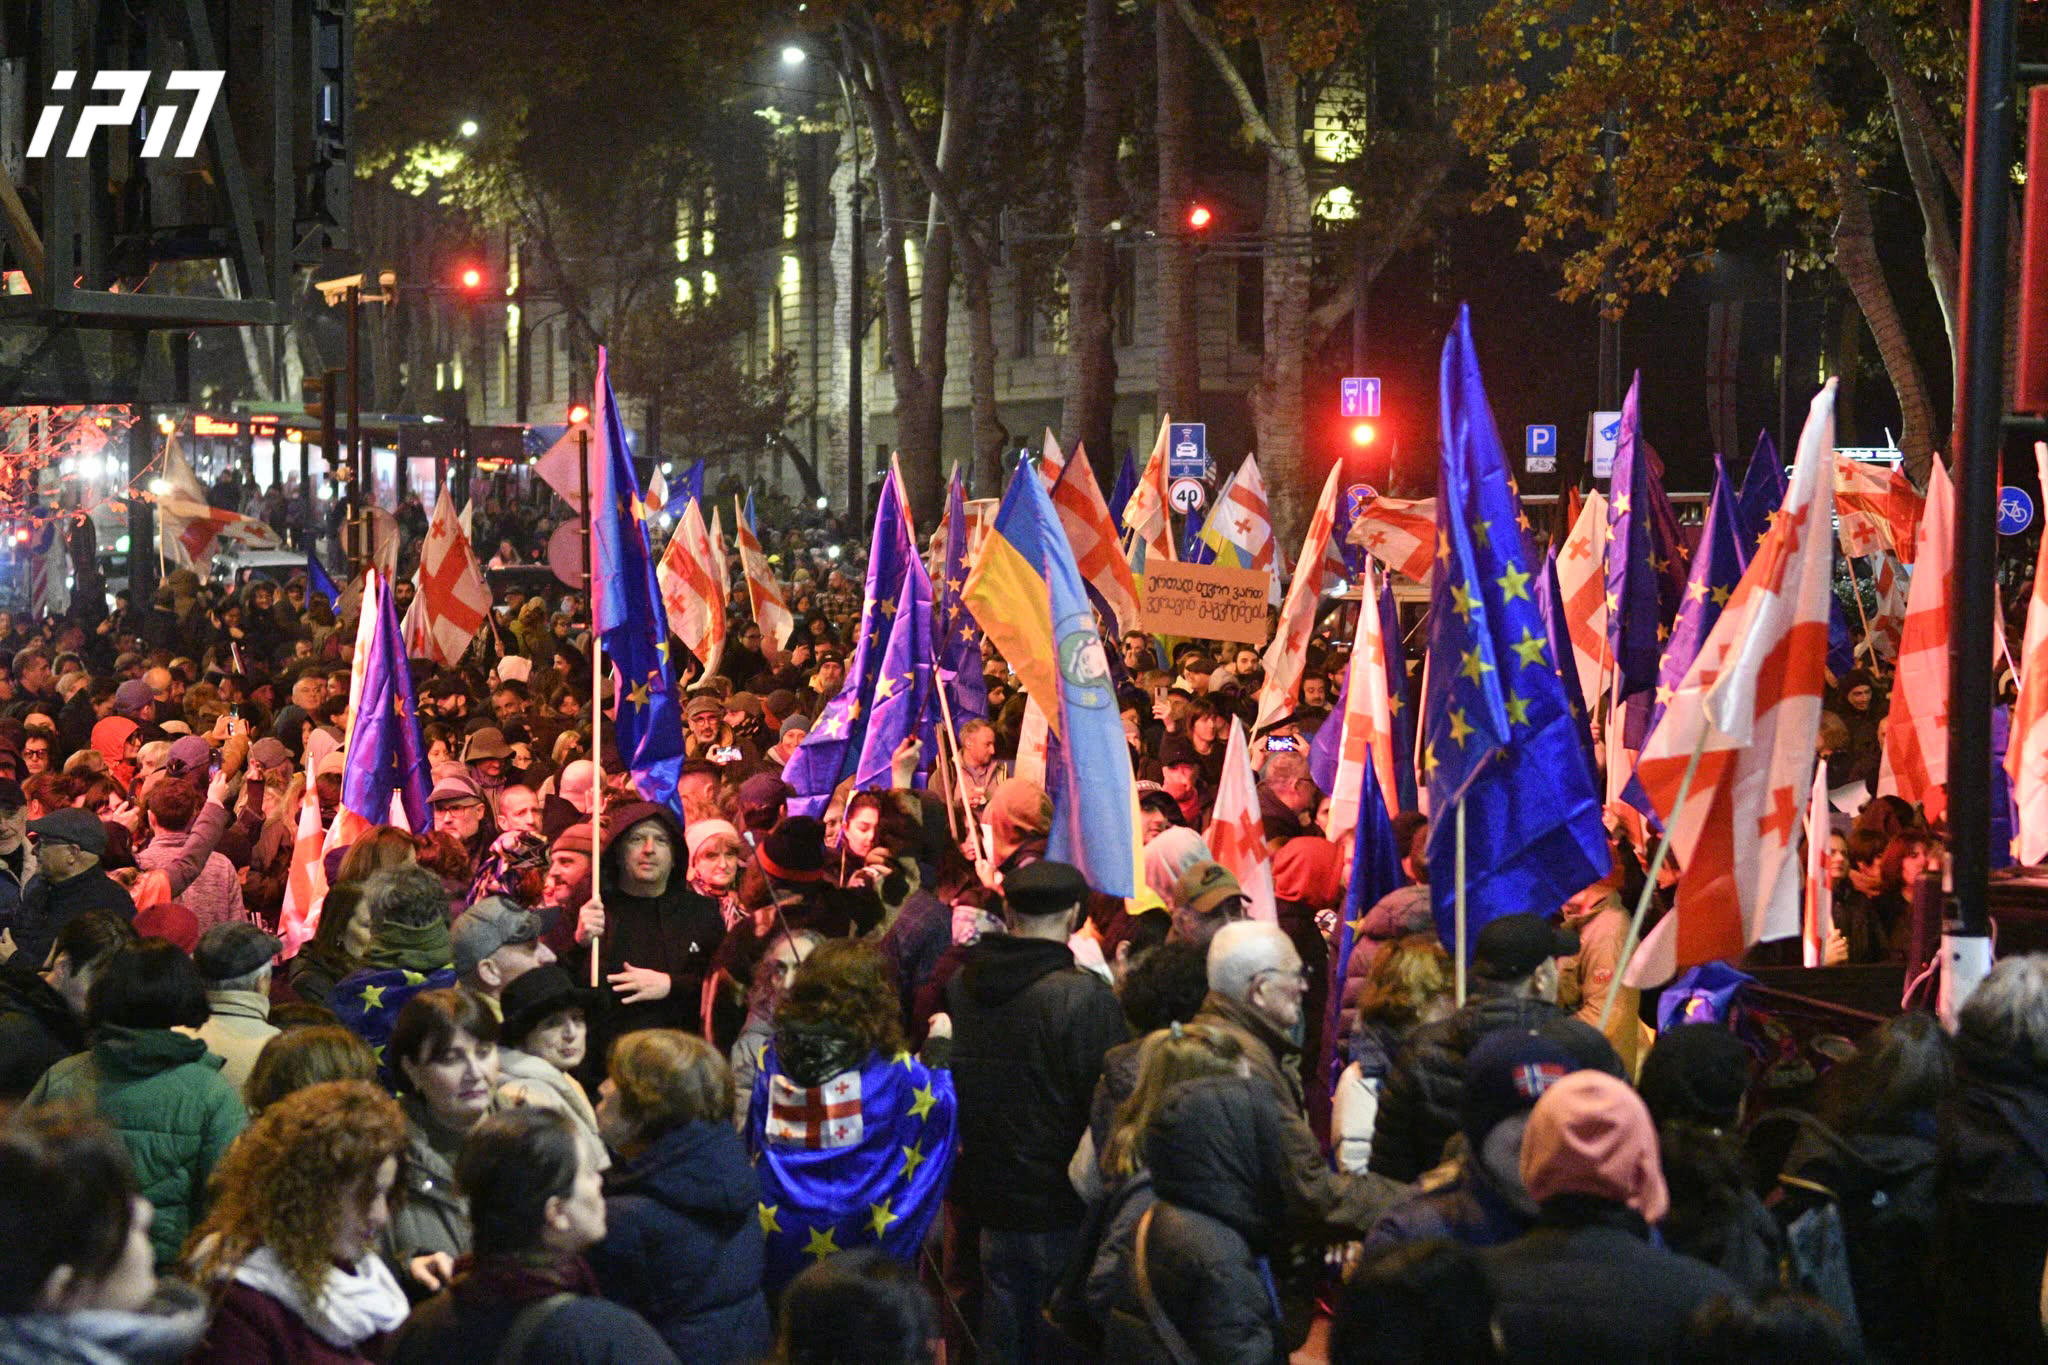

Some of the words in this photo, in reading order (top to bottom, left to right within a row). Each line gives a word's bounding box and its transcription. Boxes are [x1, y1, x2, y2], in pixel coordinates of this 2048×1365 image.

[1532, 428, 1550, 453] P
[1176, 489, 1198, 502] 40
[1148, 576, 1194, 594] ერთად
[1196, 579, 1230, 599] ბევრი
[1232, 586, 1264, 601] ვართ
